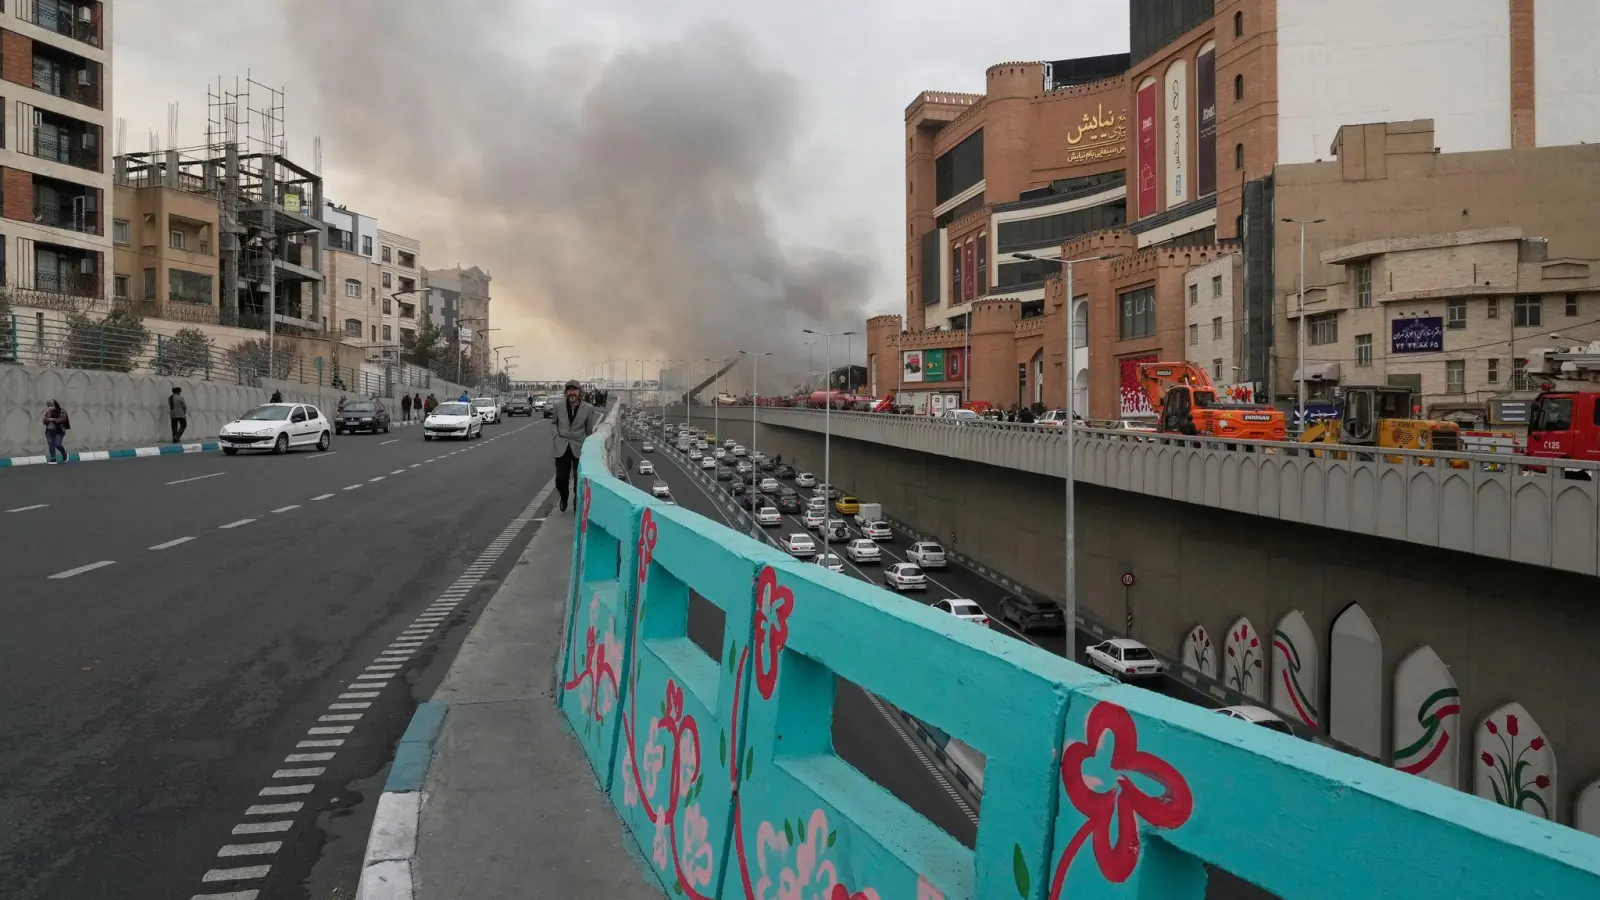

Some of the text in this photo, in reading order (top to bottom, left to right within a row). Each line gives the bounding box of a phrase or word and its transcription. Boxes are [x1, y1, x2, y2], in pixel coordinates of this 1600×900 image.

[1067, 102, 1115, 144] نیایش
[1067, 151, 1086, 162] نیایش
[1548, 441, 1560, 449] 125
